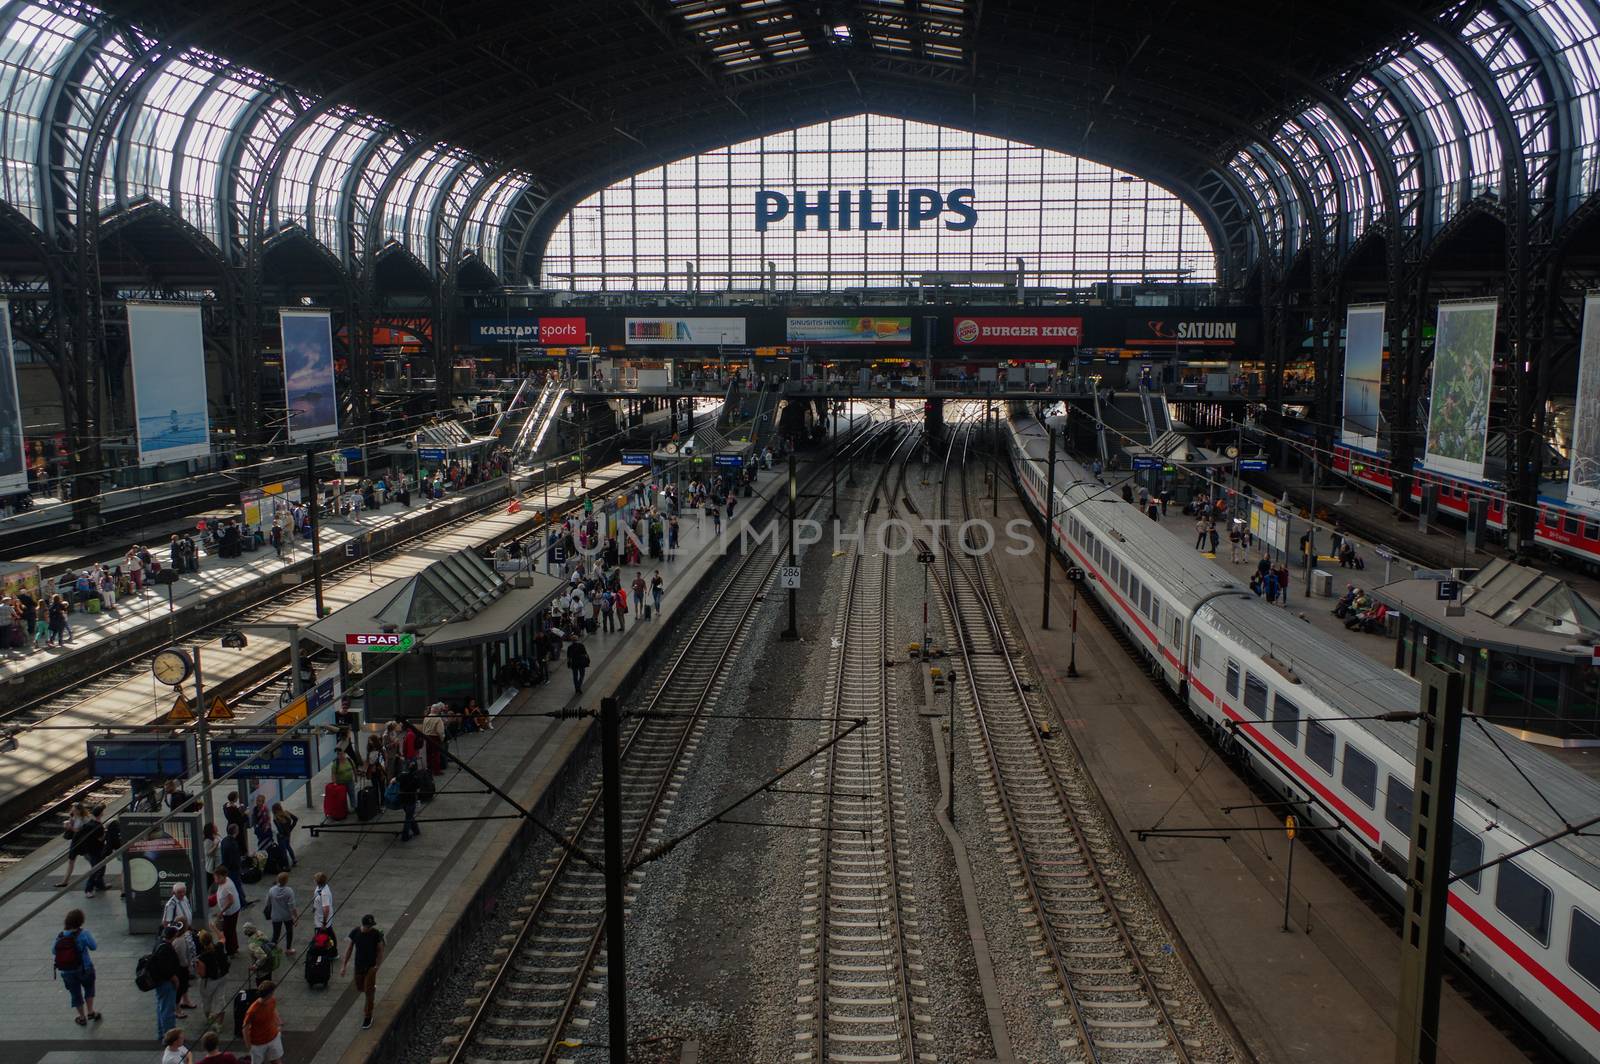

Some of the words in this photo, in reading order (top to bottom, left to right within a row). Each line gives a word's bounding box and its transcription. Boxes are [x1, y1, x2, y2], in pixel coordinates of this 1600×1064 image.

[755, 188, 978, 231] PHILIPS
[480, 326, 538, 336] KARSTADT
[541, 323, 577, 337] sports
[982, 326, 1038, 337] BURGER
[1041, 326, 1078, 337] KING
[1177, 322, 1237, 339] SATURN
[345, 544, 354, 557] E
[554, 547, 563, 560] E
[783, 568, 800, 577] 286
[787, 577, 794, 586] 6
[1440, 582, 1450, 596] E
[357, 635, 398, 644] SPAR
[95, 746, 106, 756] 7a
[292, 746, 304, 756] 8a
